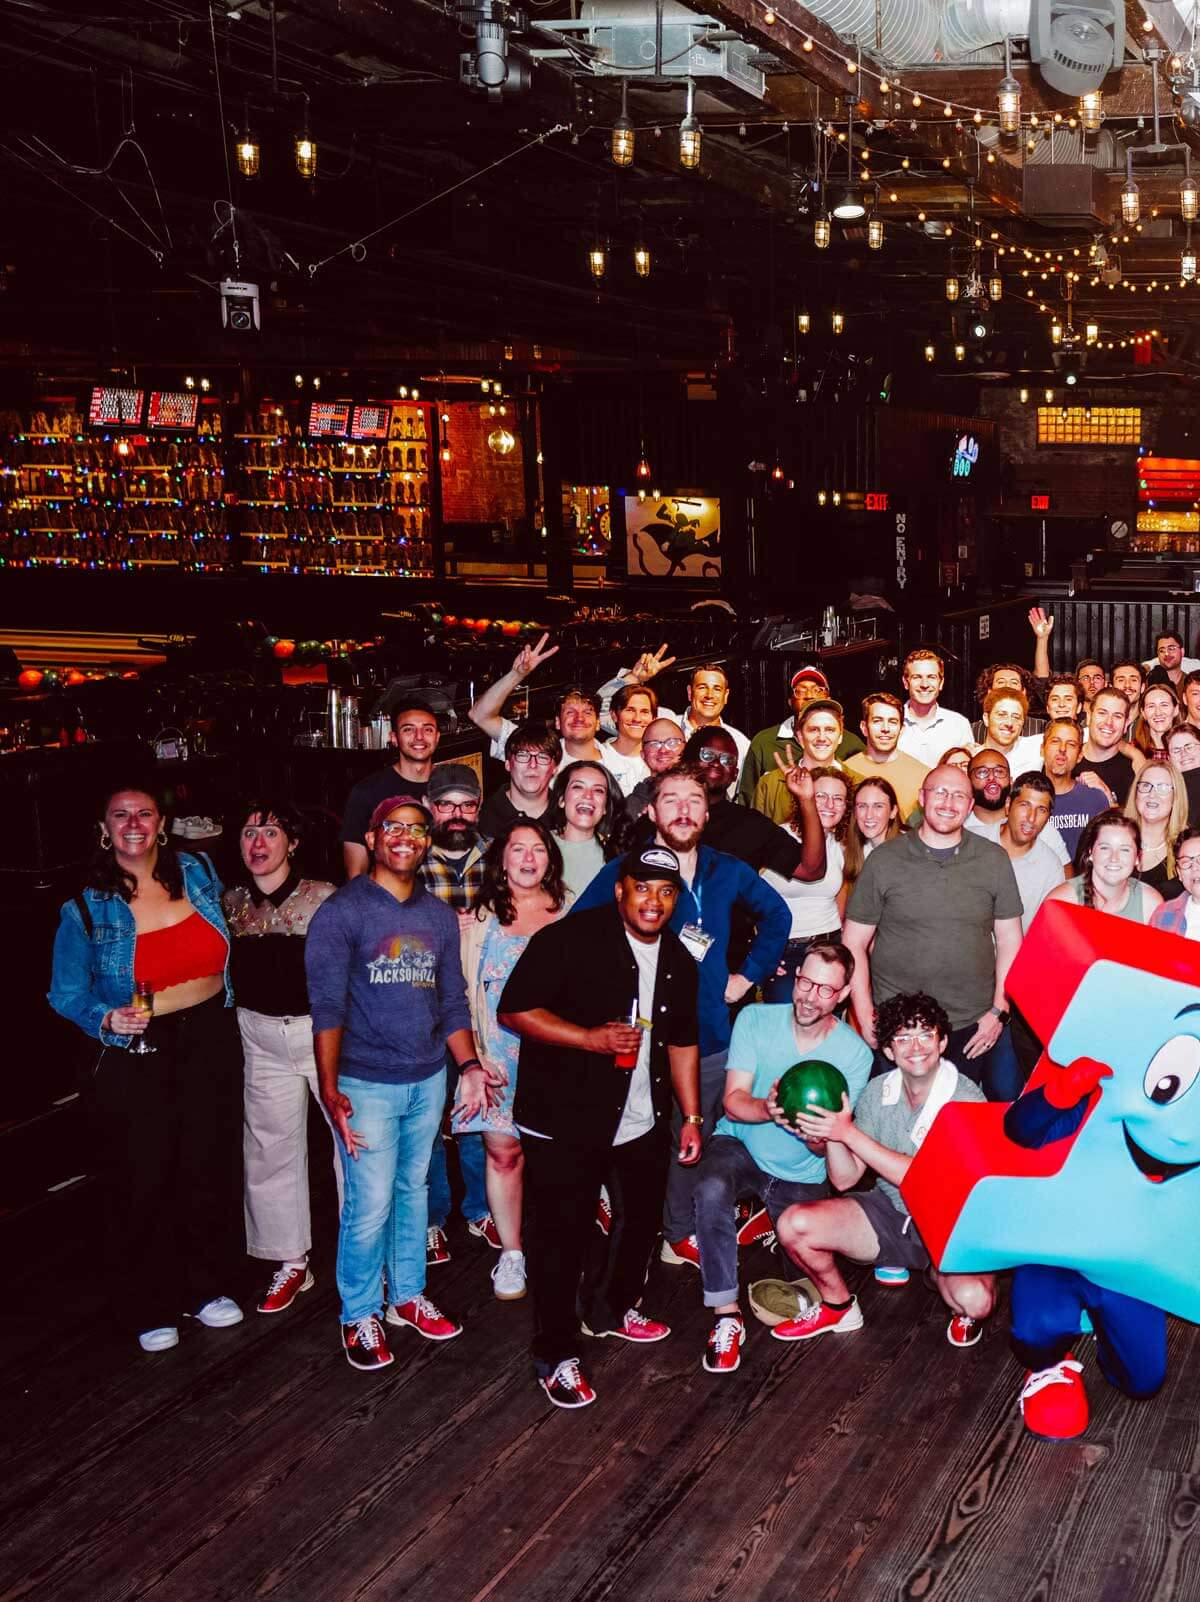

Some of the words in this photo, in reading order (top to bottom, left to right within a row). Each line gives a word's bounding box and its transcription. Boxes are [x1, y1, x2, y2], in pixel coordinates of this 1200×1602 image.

[866, 493, 888, 511] EXIT
[896, 513, 906, 533] NO
[896, 537, 907, 589] ENTRY
[1048, 813, 1089, 829] ROSSBEAM
